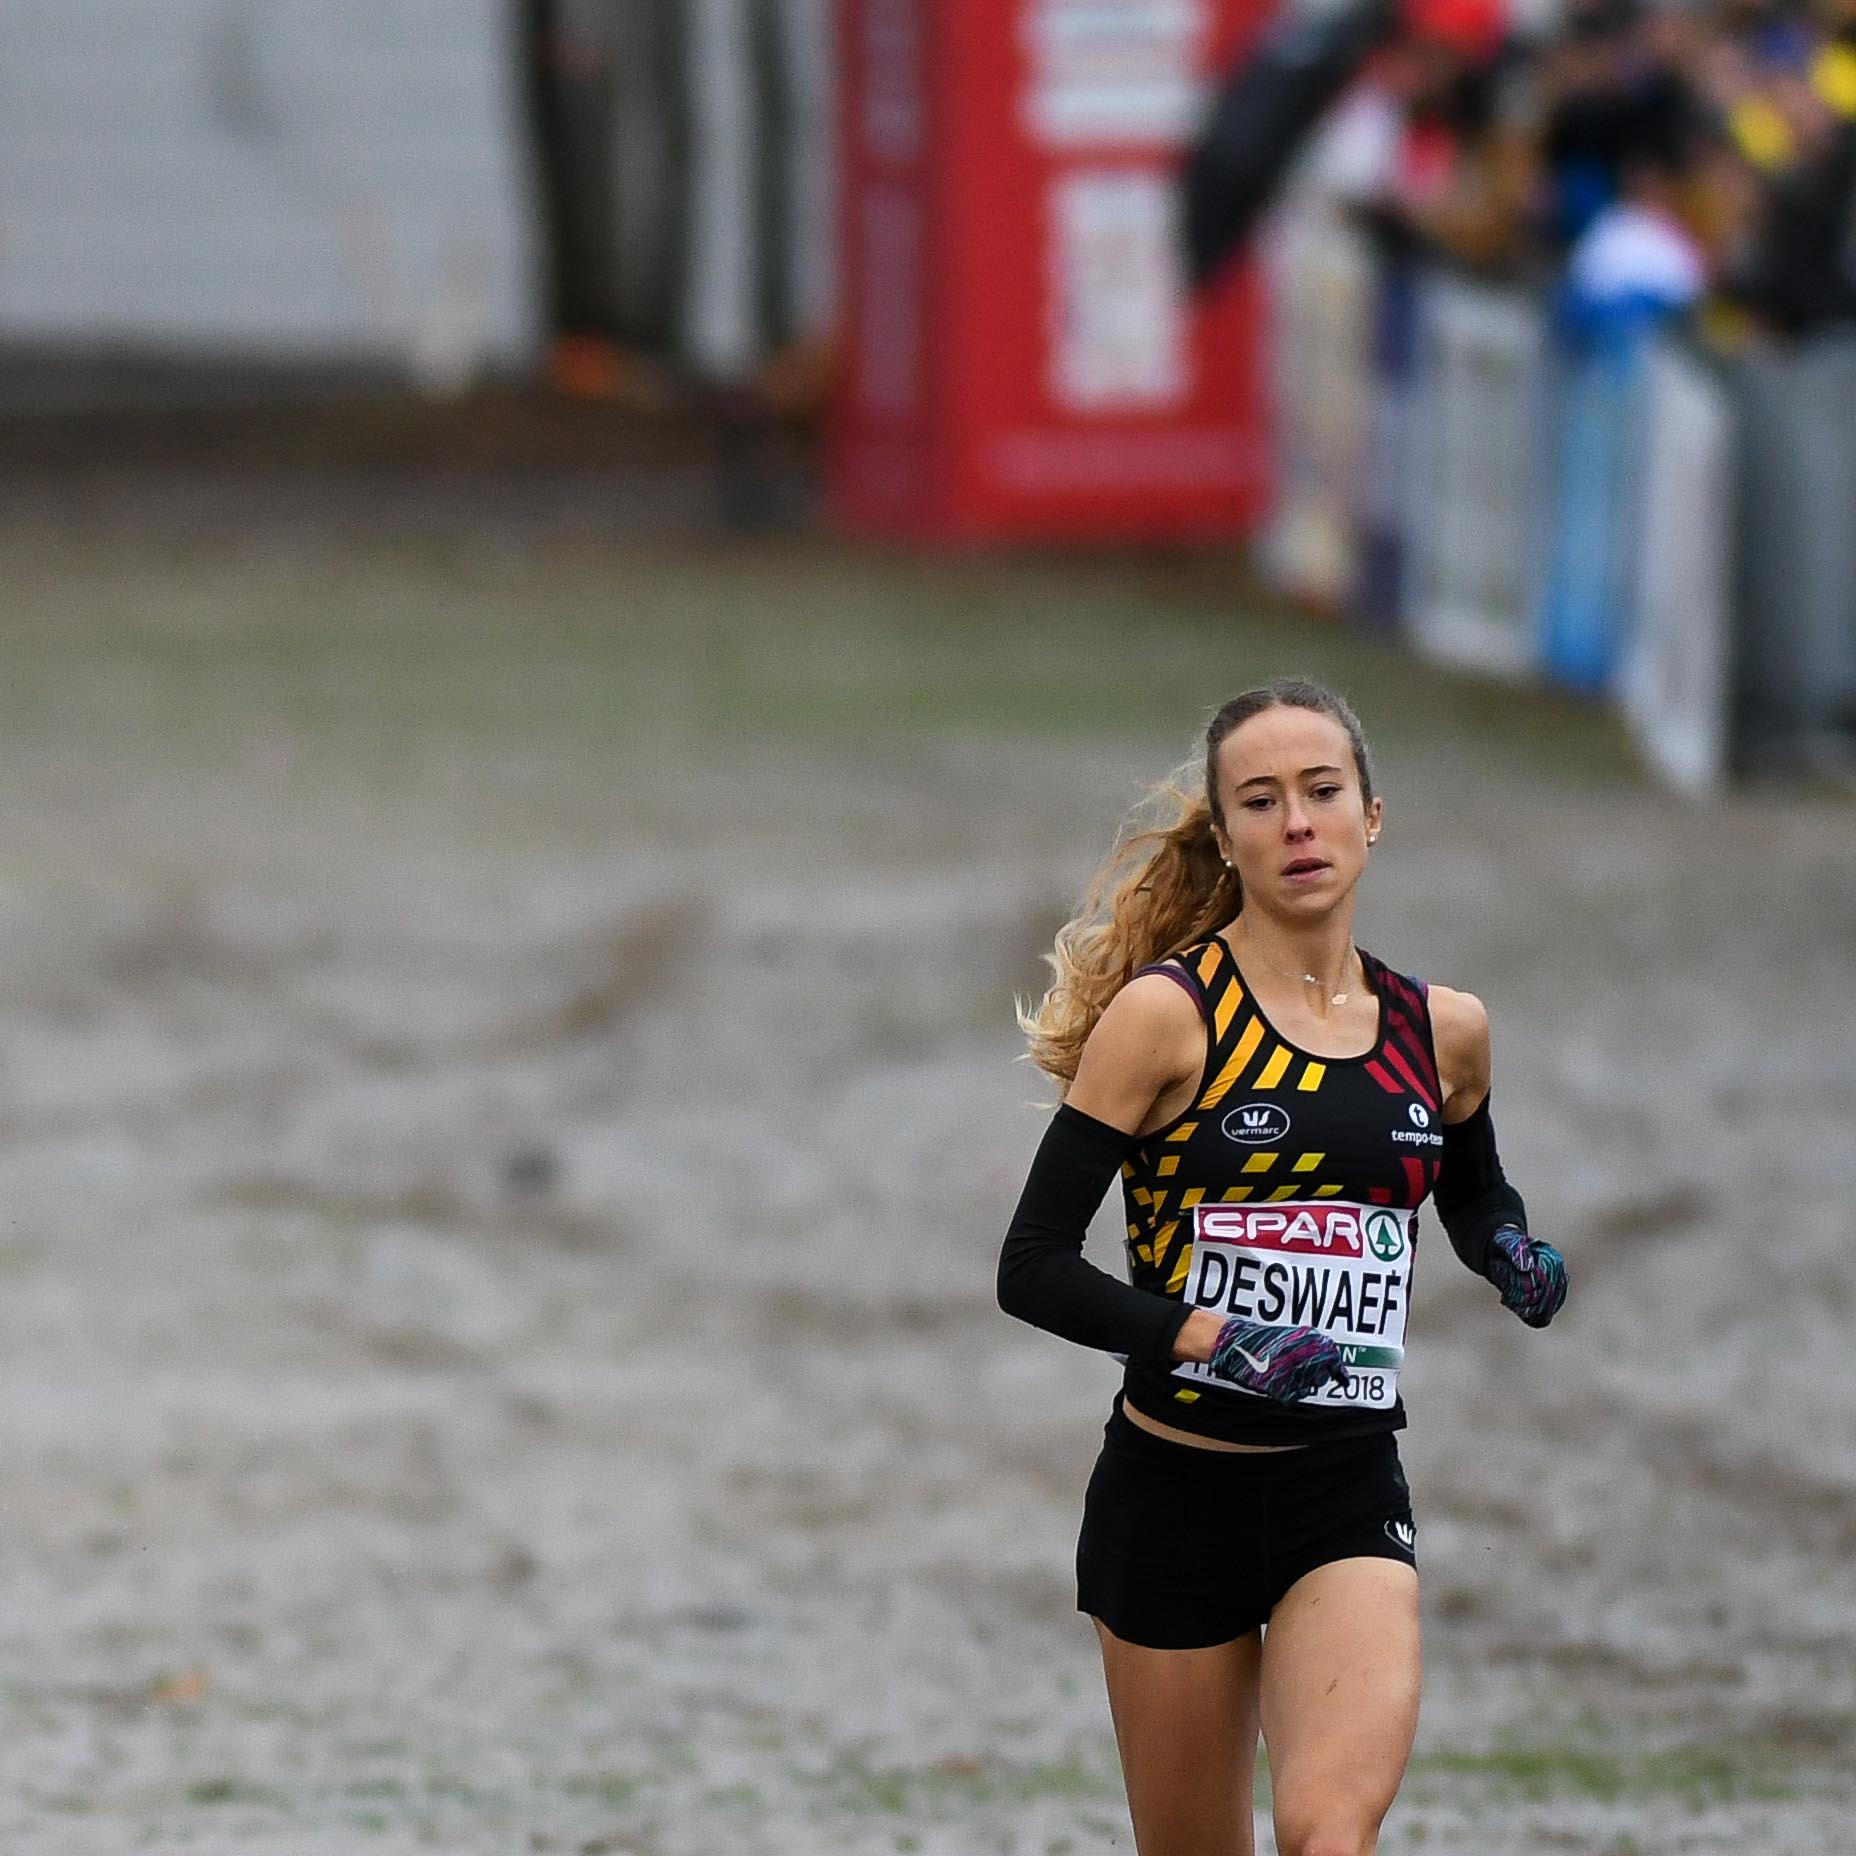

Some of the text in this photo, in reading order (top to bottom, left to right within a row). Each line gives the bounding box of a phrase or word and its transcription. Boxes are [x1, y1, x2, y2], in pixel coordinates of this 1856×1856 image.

[1231, 1126, 1280, 1136] vermarc
[1204, 1211, 1361, 1250] SPAR
[1194, 1250, 1402, 1336] DESWAEF
